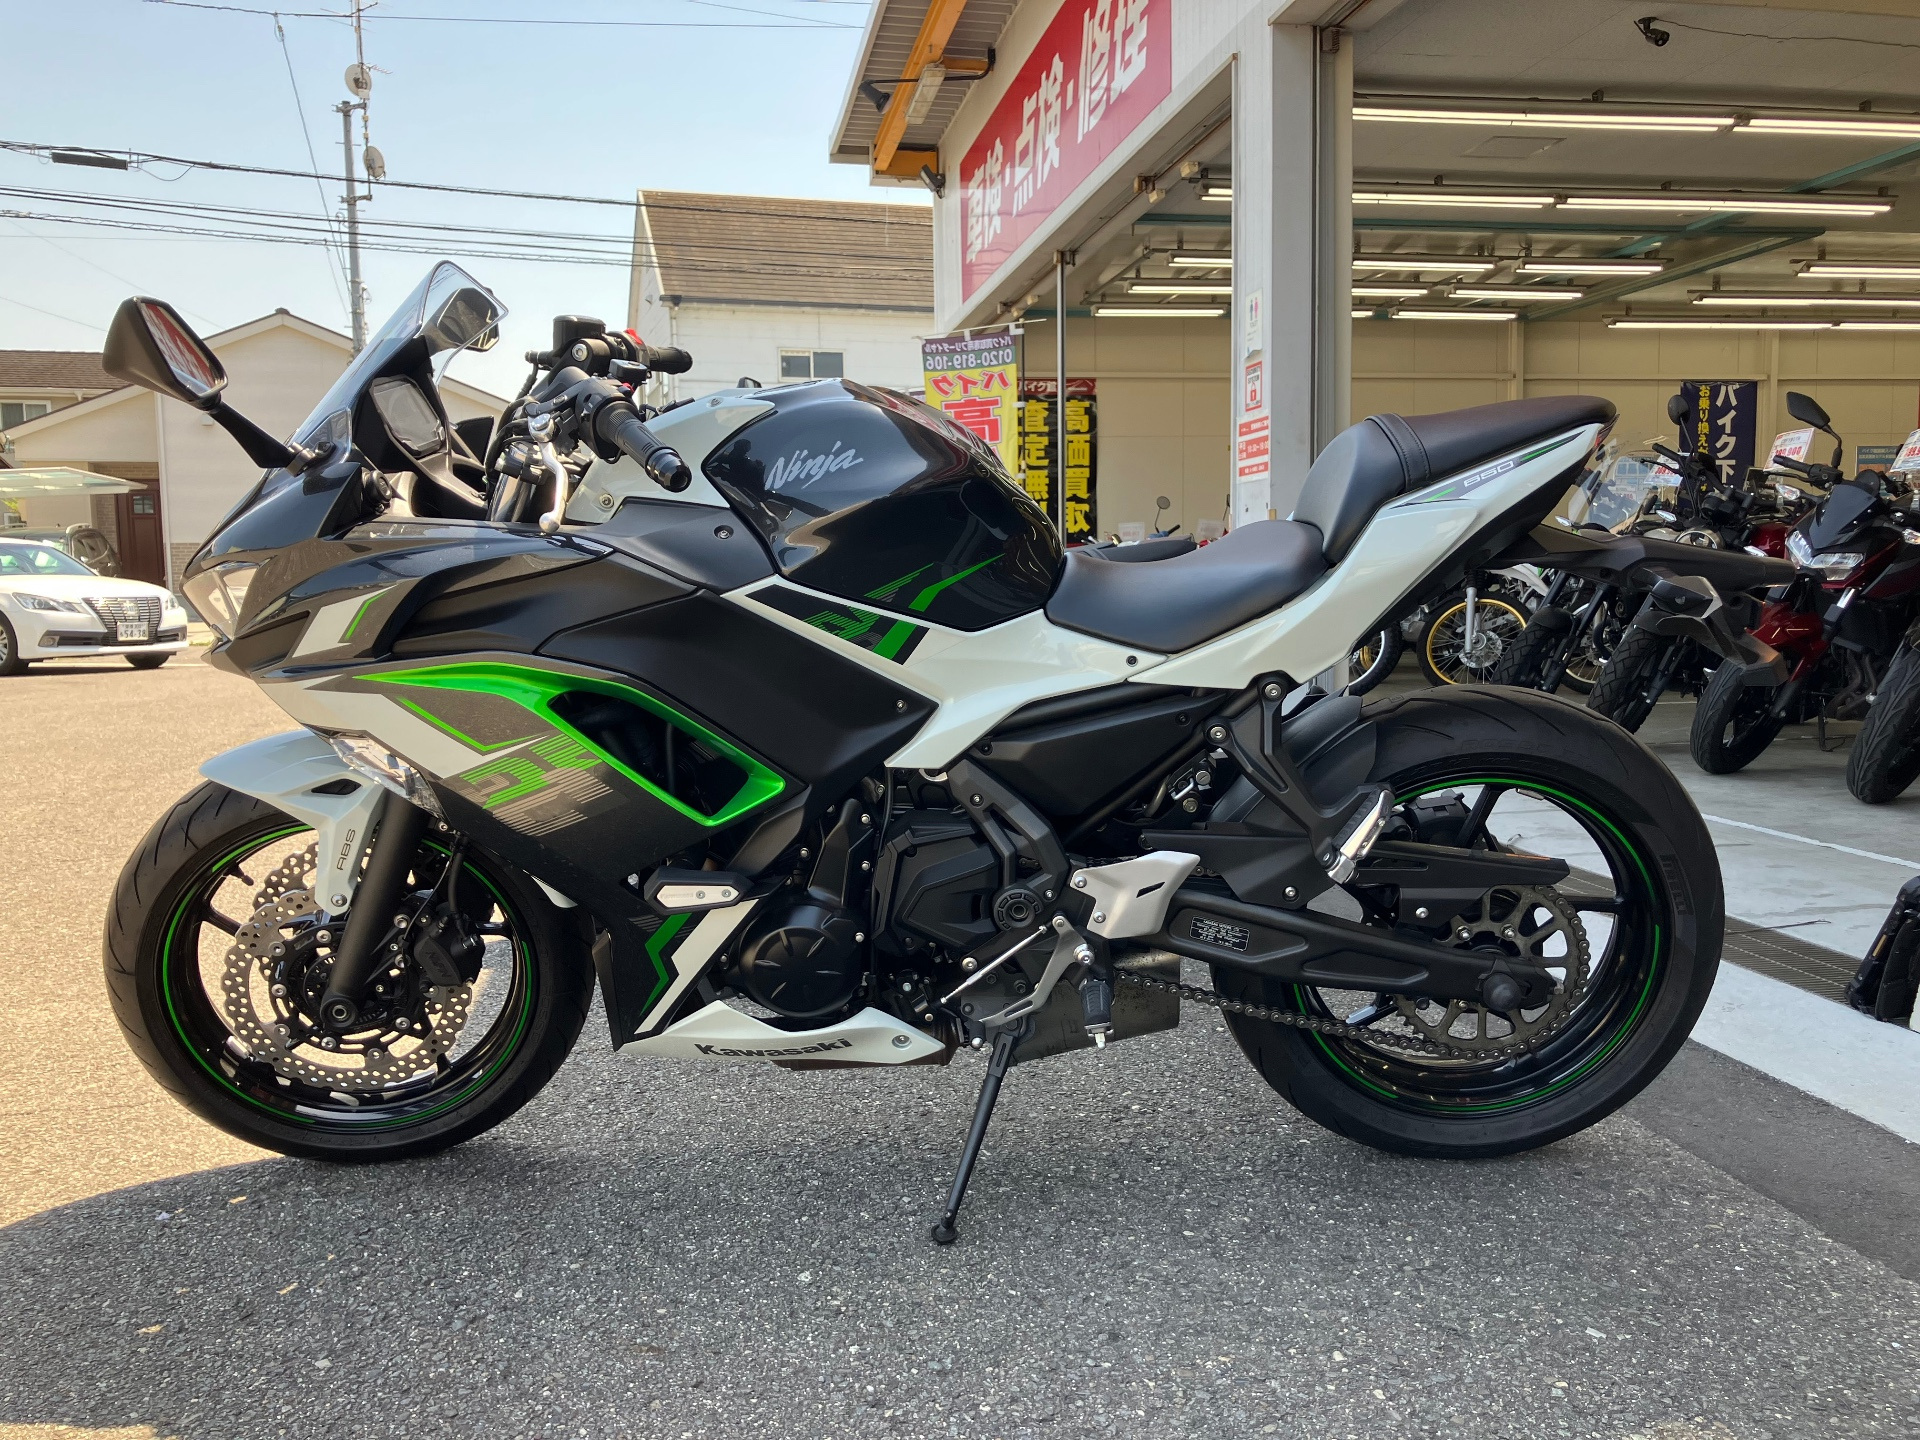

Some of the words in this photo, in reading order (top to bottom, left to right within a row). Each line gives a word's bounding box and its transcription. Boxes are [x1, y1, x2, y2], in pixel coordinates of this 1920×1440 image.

[764, 440, 864, 490] Ninja
[1463, 460, 1514, 487] 650
[336, 828, 356, 871] ABS
[694, 1038, 853, 1057] Kawasaki
